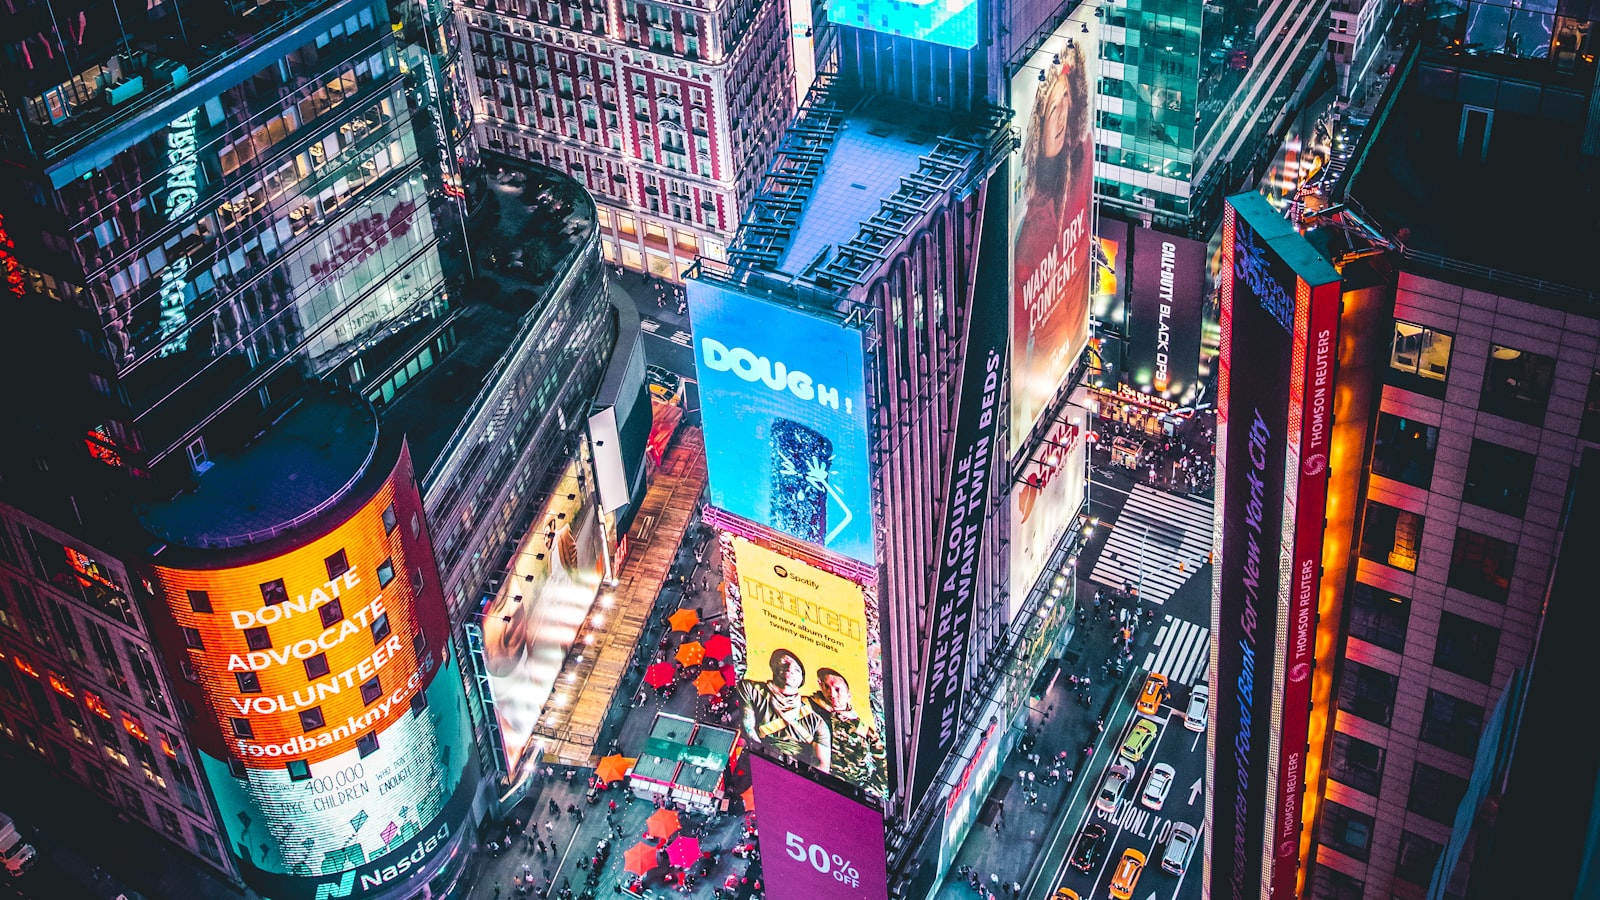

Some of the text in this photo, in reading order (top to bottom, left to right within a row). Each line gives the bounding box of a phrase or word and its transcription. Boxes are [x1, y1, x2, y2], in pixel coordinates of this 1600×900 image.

[1022, 243, 1060, 311] WARM.
[1062, 208, 1085, 259] DRY.
[1029, 246, 1078, 332] CONTENT.
[1155, 241, 1176, 381] CALL DUTY BLACK OPS
[1309, 328, 1330, 449] THOMSON REUTERS
[1249, 407, 1271, 471] City
[947, 444, 974, 569] COUPLE.
[968, 436, 990, 516] TWIN
[1245, 469, 1265, 534] York
[230, 565, 361, 630] DONATE
[789, 572, 820, 590] Spotify
[944, 569, 958, 593] A
[956, 523, 978, 608] WANT
[1241, 531, 1261, 601] New
[227, 594, 387, 672] ADVOCATE
[743, 575, 861, 642] TRENCH
[762, 608, 845, 648] The new album from
[769, 620, 839, 653] twenty one pilots
[1240, 595, 1258, 645] For
[1296, 559, 1313, 660] THOMSON REUTERS
[230, 634, 403, 715] VOLUNTEER
[945, 612, 967, 698] DON'T
[1237, 639, 1256, 706] Bank
[237, 652, 435, 758] foodbanknyc.org
[939, 700, 955, 749] WE
[1235, 695, 1253, 764] Food
[280, 781, 370, 816] NYC CHILDREN
[304, 762, 365, 795] 400,000
[1234, 752, 1249, 790] of
[1283, 751, 1299, 838] THOMSON REUTERS
[1097, 797, 1131, 826] ONLY
[1124, 807, 1162, 841] ONLY
[1233, 784, 1248, 883] supporter
[361, 821, 450, 891] Nasdaq
[785, 831, 860, 880] 50%
[832, 870, 860, 889] OFF
